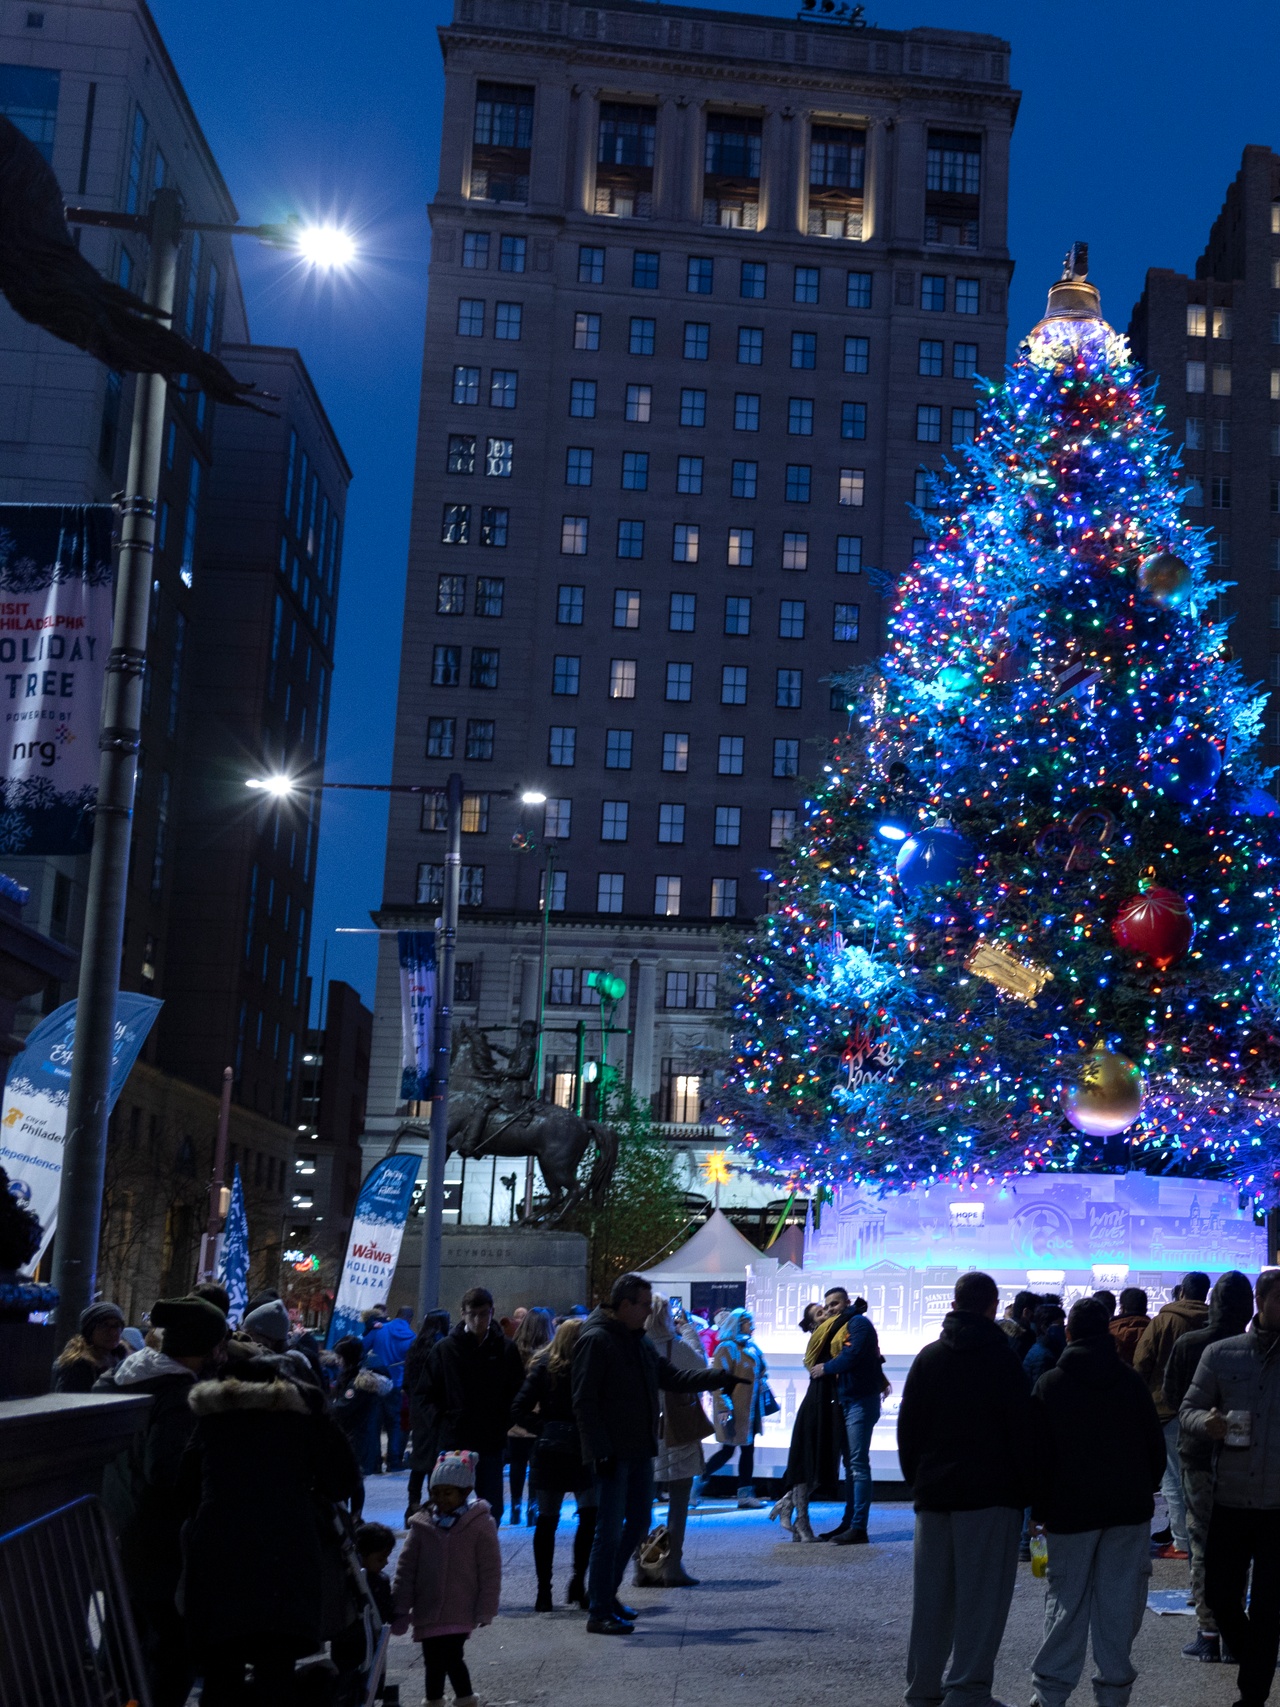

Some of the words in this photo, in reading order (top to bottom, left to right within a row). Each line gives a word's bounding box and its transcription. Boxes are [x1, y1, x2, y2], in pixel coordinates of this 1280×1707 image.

[0, 616, 85, 631] HILADELPHIA
[0, 635, 97, 663] OLIDAY
[5, 670, 75, 699] TREE
[6, 710, 56, 723] POWERED
[59, 711, 72, 722] BY
[12, 740, 57, 767] nrg
[25, 1115, 39, 1125] City
[39, 1118, 48, 1126] of
[20, 1123, 67, 1147] Philadel
[0, 1146, 62, 1172] dependence
[956, 1211, 978, 1219] HOPE
[1089, 1206, 1128, 1227] WITH
[1046, 1235, 1073, 1249] abc
[352, 1243, 392, 1264] Wawa
[346, 1260, 394, 1278] HOLIDAY
[350, 1275, 384, 1288] PLAZA
[925, 1293, 954, 1303] MANTU
